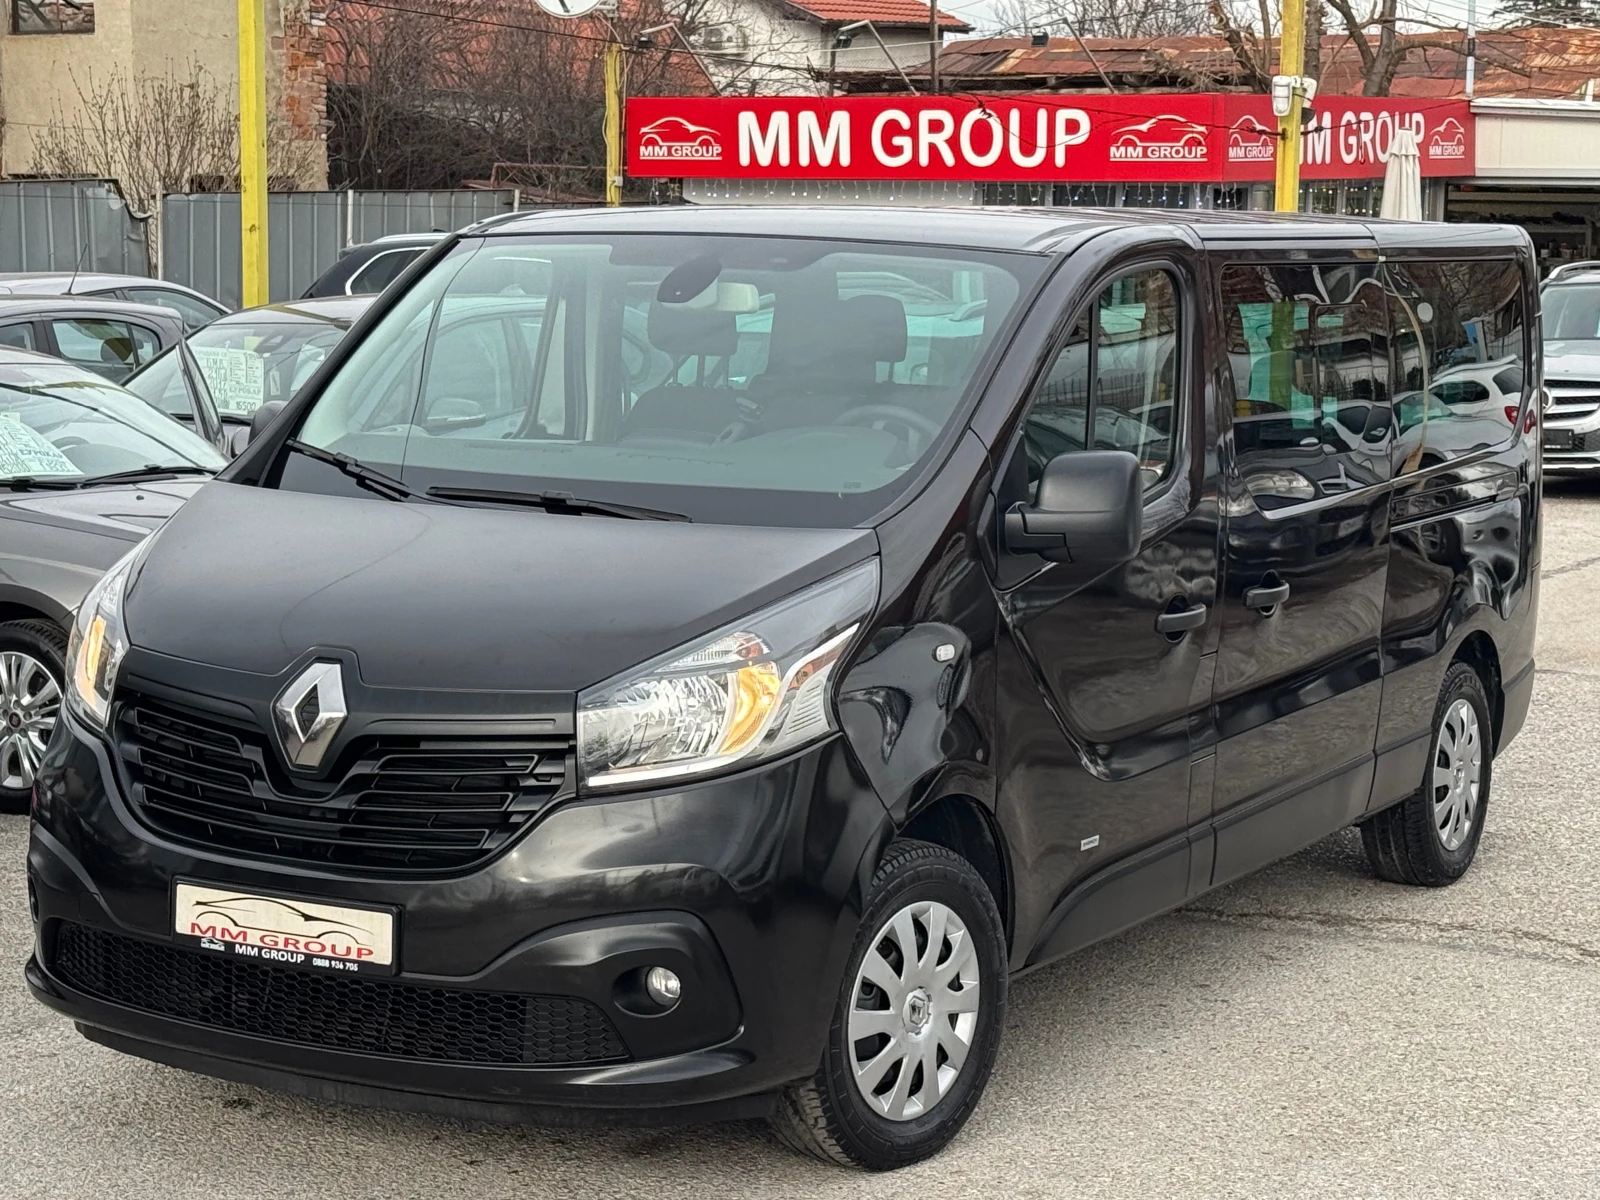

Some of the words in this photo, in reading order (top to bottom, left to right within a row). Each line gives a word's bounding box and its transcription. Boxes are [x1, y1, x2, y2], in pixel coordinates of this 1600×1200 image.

[738, 110, 851, 167] MM
[871, 107, 1091, 168] GROUP
[1299, 110, 1332, 165] M
[640, 145, 668, 157] MM
[671, 145, 722, 157] GROUP
[1110, 146, 1142, 158] MM
[1147, 146, 1208, 158] GROUP
[1228, 147, 1245, 158] MM
[1246, 146, 1274, 158] GROUP
[1429, 145, 1442, 156] MM
[1442, 145, 1465, 156] GROUP
[191, 922, 248, 942] MM
[259, 934, 374, 959] GROUP
[235, 944, 259, 957] MM
[261, 948, 305, 964] GROUP
[312, 958, 330, 968] 0888
[331, 960, 344, 970] 936
[345, 961, 359, 971] 705
